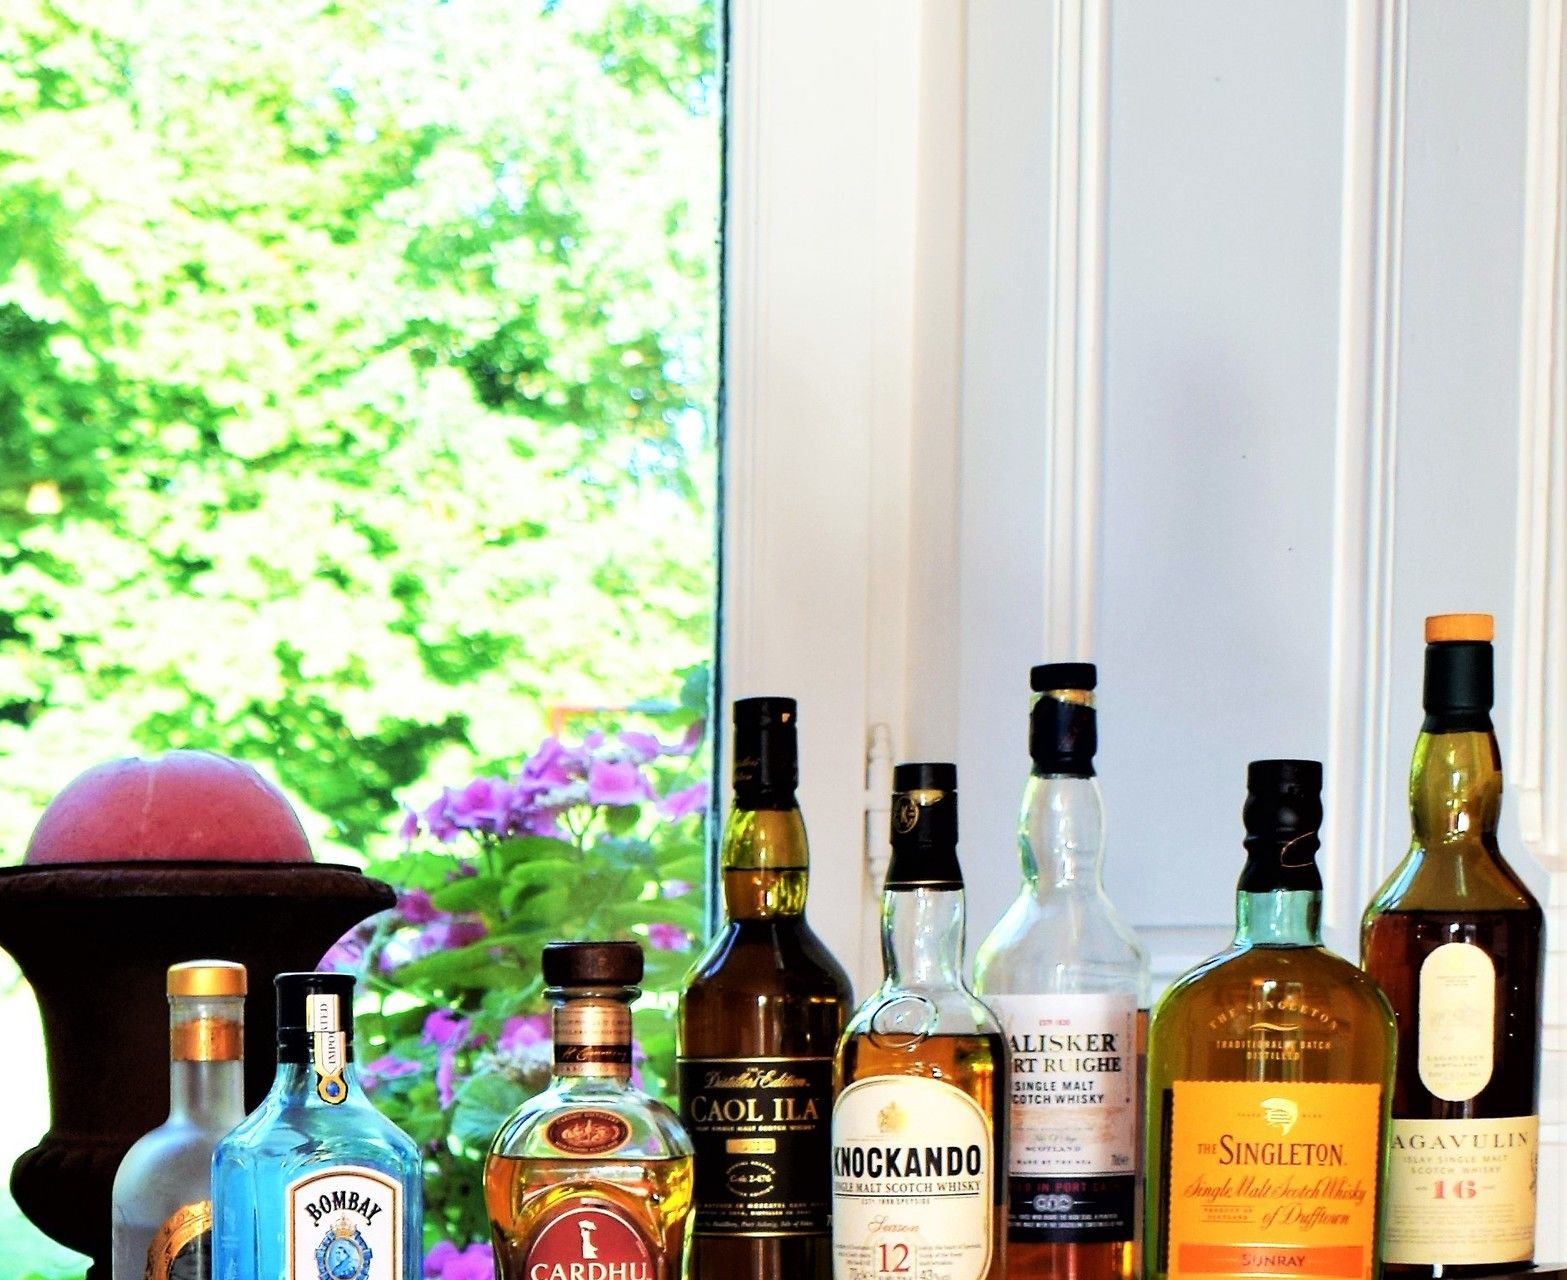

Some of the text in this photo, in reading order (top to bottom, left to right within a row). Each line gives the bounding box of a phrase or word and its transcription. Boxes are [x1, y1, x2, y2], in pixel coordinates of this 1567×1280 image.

[1044, 1057, 1122, 1072] RUIGHE
[1014, 1081, 1094, 1091] SINGLE MALT
[691, 1096, 819, 1122] CAOL ILA
[1056, 1094, 1104, 1104] WHISKY
[834, 1145, 981, 1178] KNOCKANDO
[1198, 1134, 1343, 1167] THE SINGLETON
[1462, 1166, 1501, 1174] WHISKY
[856, 1183, 881, 1193] MALT
[886, 1183, 933, 1193] SCOTCH
[937, 1181, 981, 1192] WHISKY
[1183, 1173, 1367, 1206] Single Malt Scotch Whisky
[1432, 1180, 1477, 1200] 16
[305, 1190, 382, 1227] BOMBAY
[1260, 1204, 1283, 1229] of
[879, 1243, 911, 1273] 12
[1242, 1254, 1306, 1267] SUNRAY
